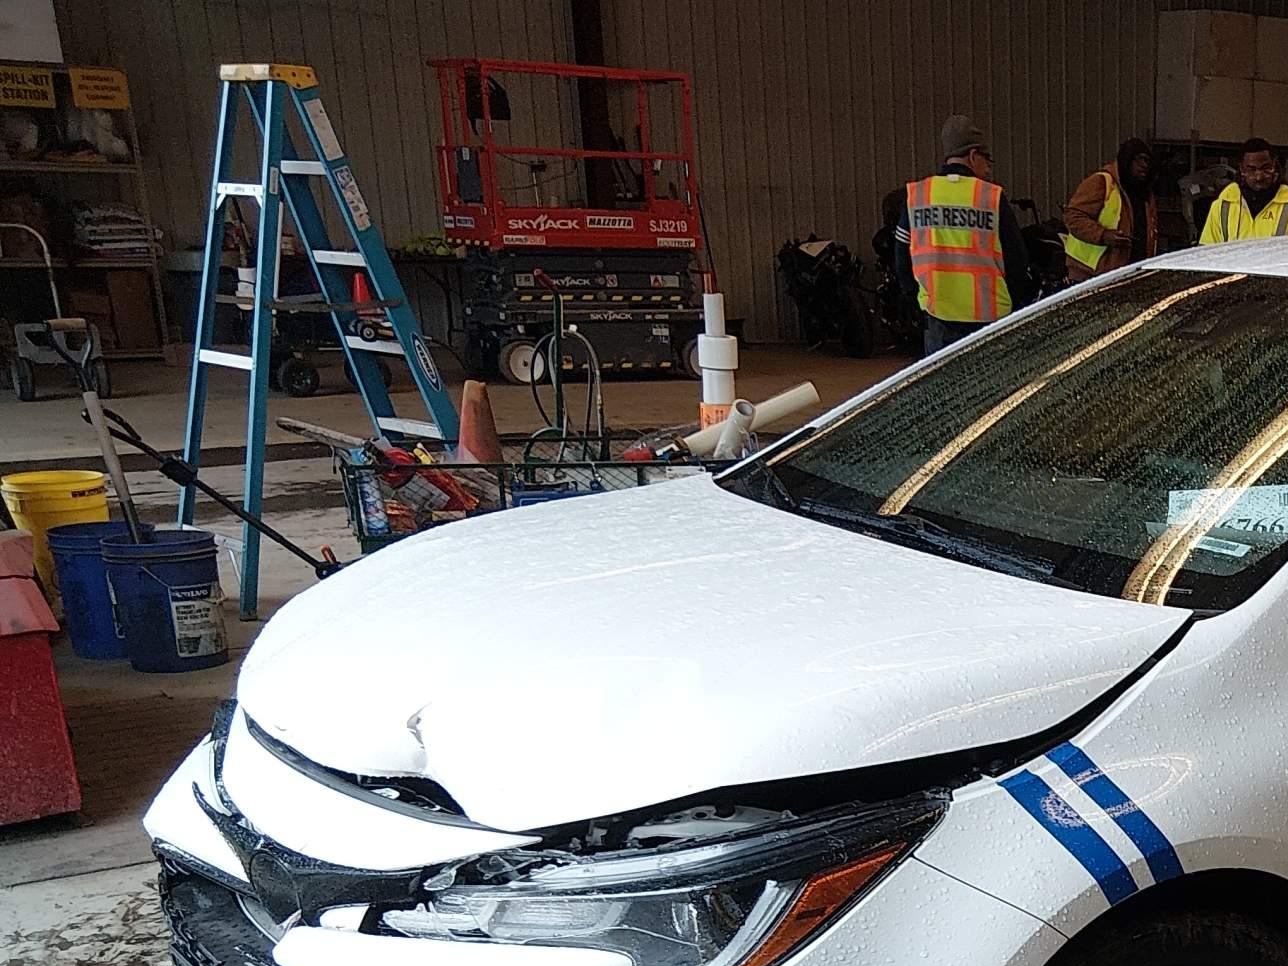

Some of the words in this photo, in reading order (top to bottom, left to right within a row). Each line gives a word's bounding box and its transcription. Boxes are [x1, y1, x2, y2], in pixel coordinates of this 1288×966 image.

[2, 85, 47, 99] STATION
[507, 214, 580, 231] SKYJACK
[588, 217, 633, 228] MAZZOTTA
[913, 207, 939, 228] FIRE
[942, 207, 994, 230] RESCUE
[649, 219, 688, 233] SJ3219
[551, 275, 591, 287] KYJACK
[590, 310, 633, 321] SKYJACK
